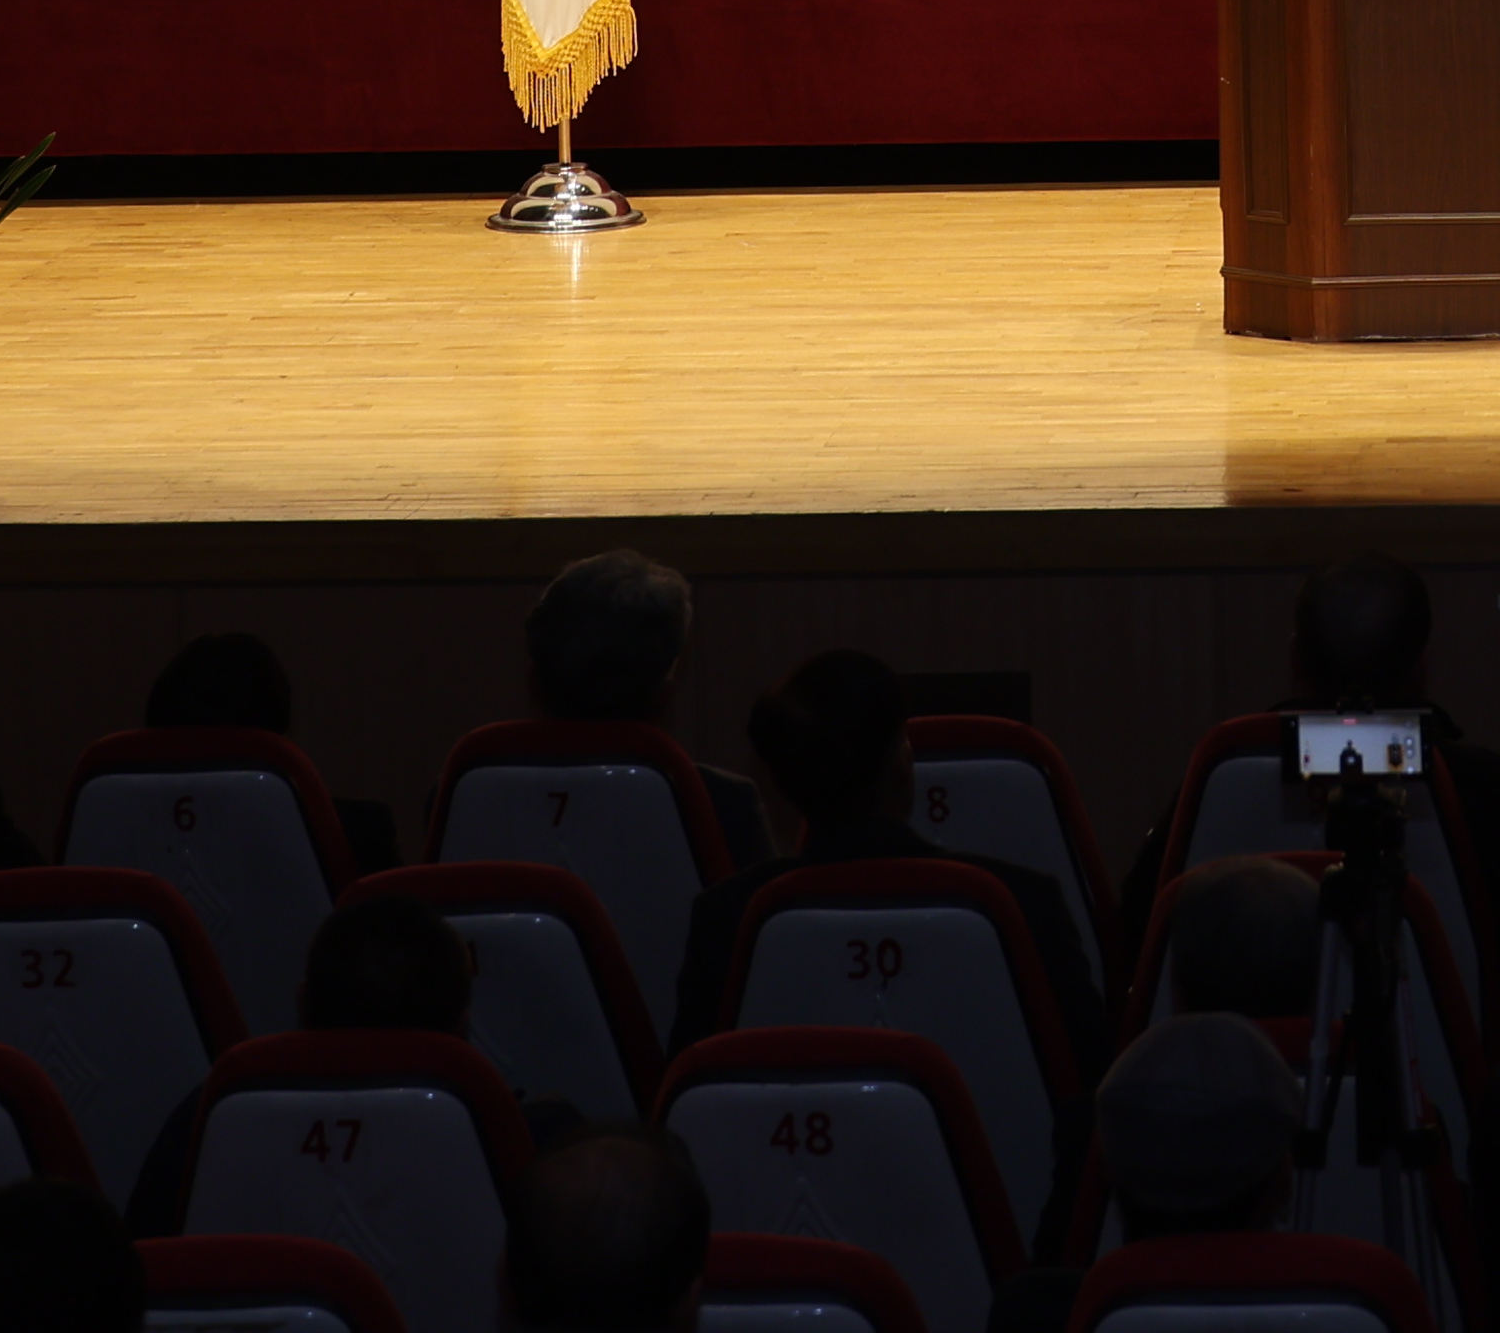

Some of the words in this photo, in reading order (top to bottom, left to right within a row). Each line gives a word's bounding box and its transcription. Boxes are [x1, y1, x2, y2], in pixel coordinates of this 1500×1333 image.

[173, 796, 196, 831] 6
[548, 792, 568, 827] 7
[926, 786, 949, 823] 8
[21, 949, 75, 989] 32
[847, 938, 903, 981] 30
[301, 1119, 361, 1163] 47
[770, 1112, 833, 1156] 48
